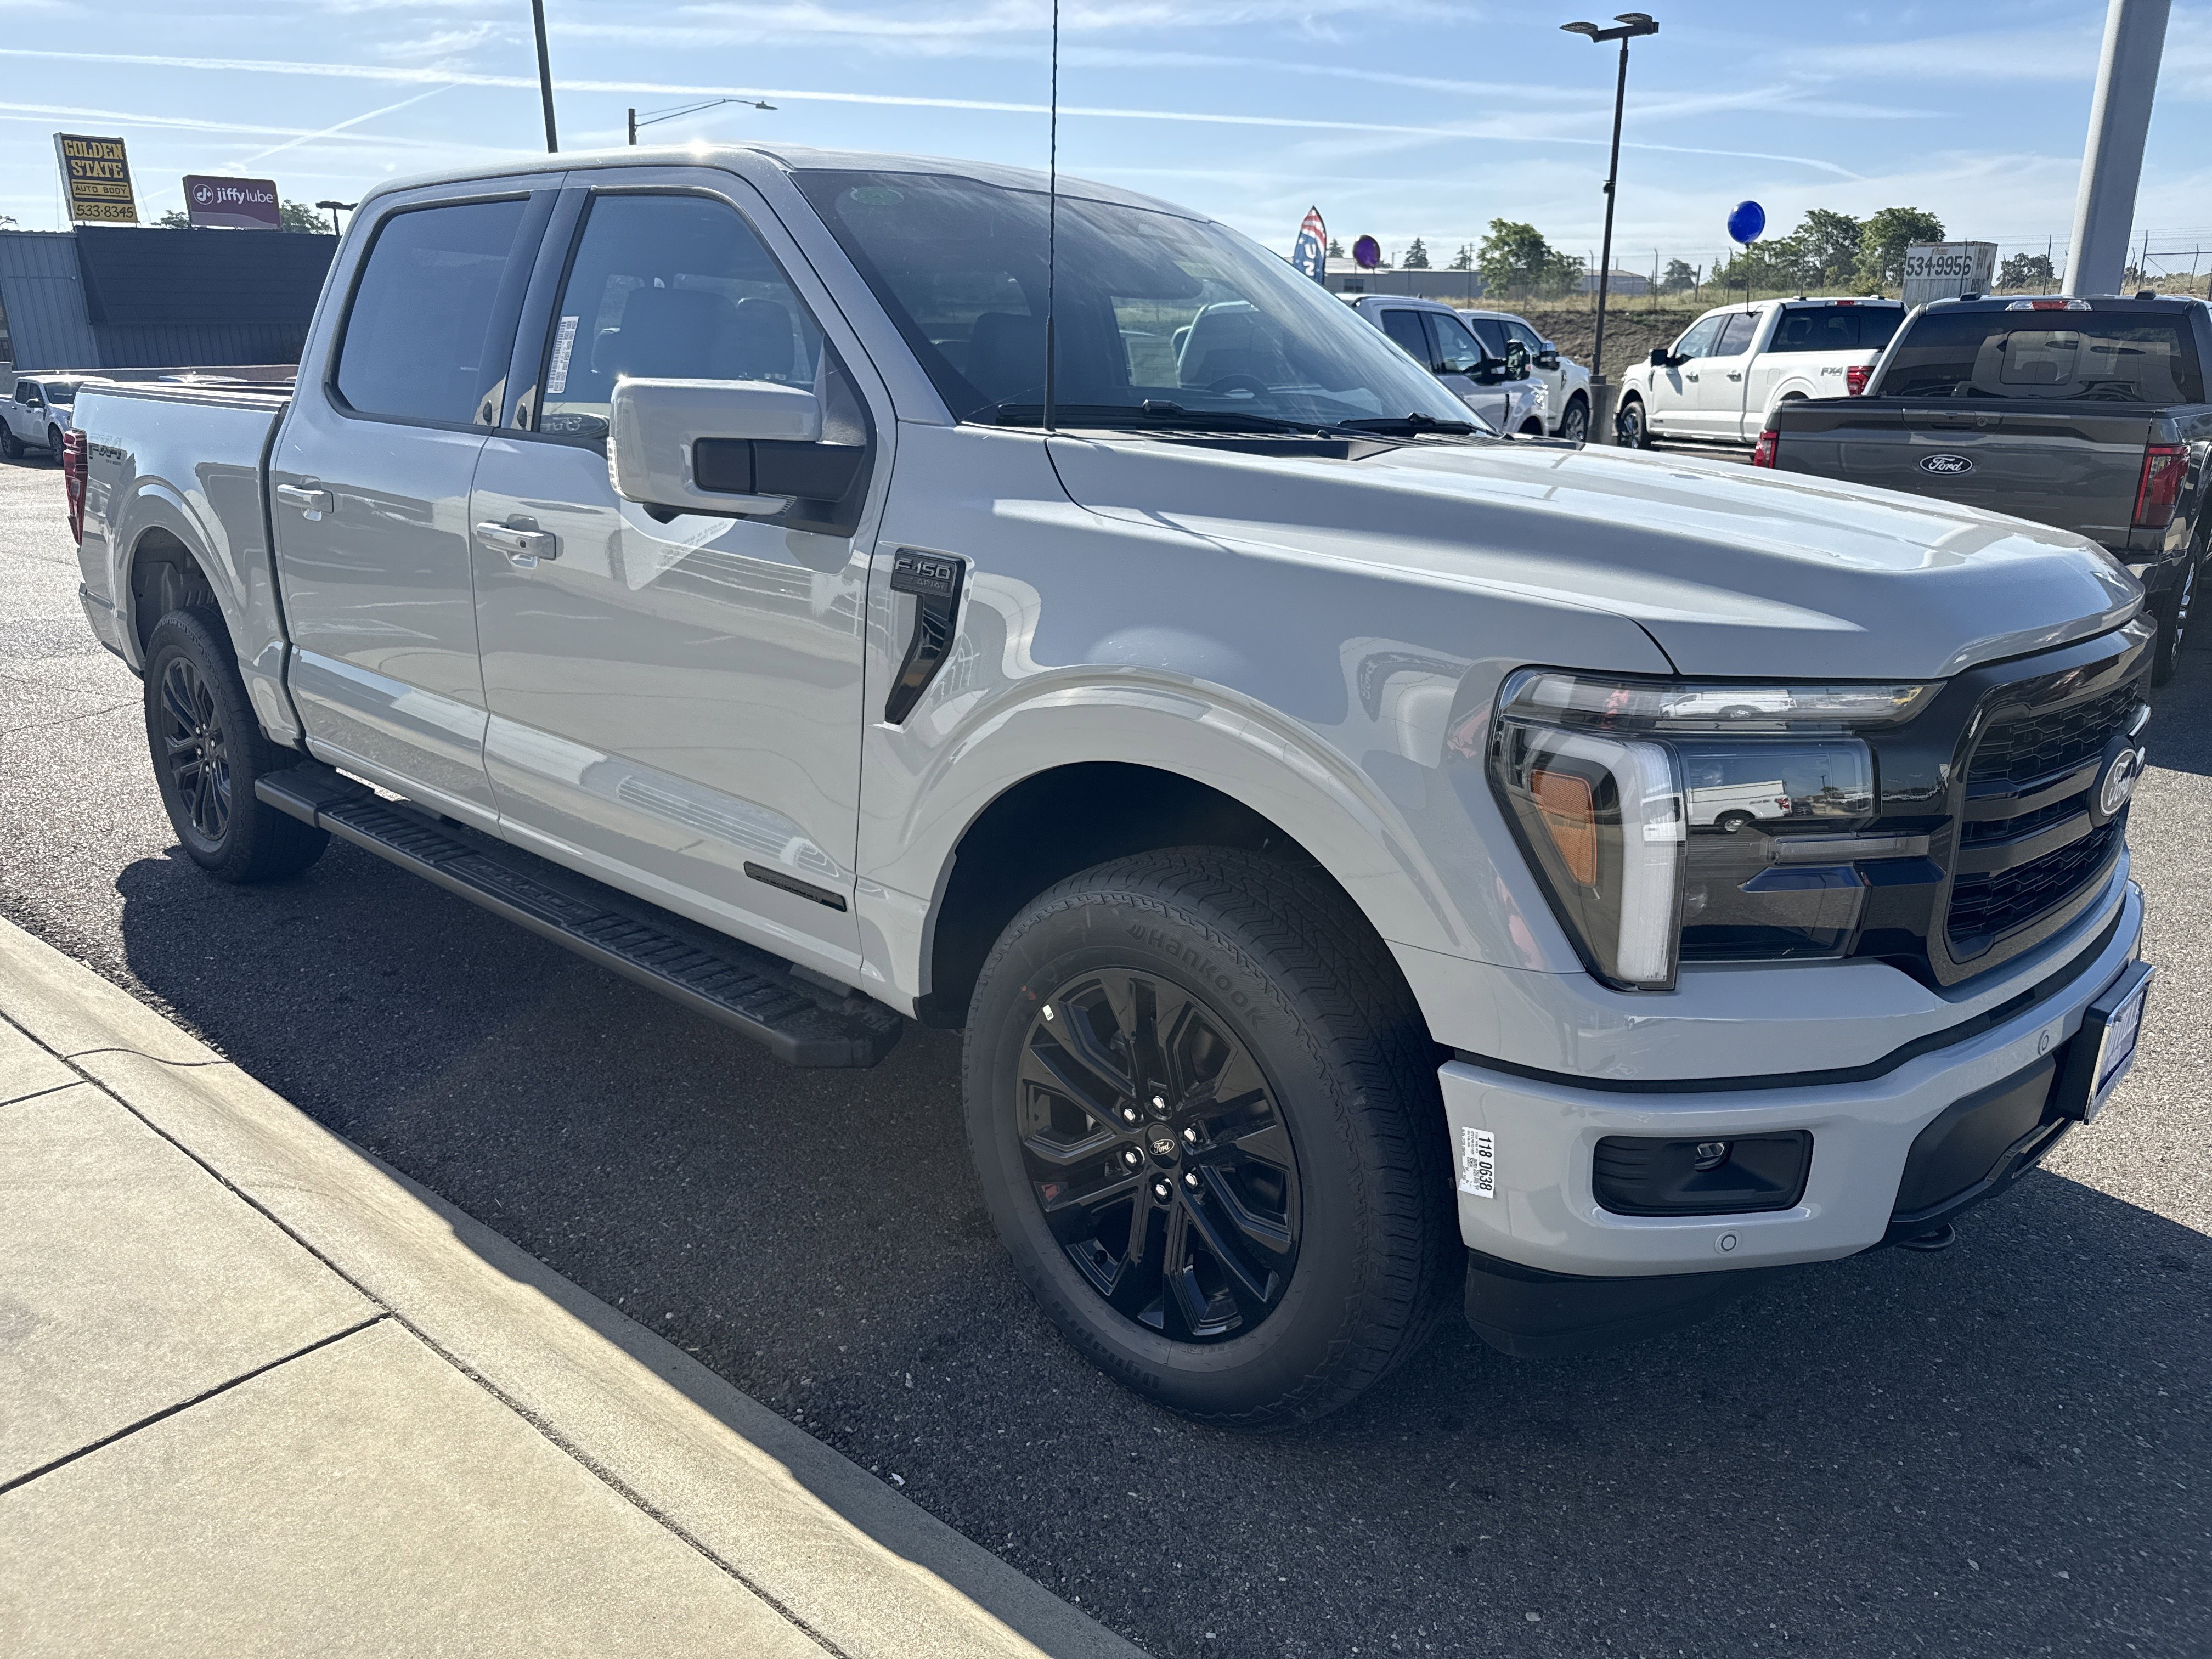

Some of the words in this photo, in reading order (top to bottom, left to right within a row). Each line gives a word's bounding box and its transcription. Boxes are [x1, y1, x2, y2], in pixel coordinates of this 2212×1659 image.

[64, 139, 124, 160] GOLDEN
[71, 159, 124, 178] STATE
[1928, 456, 1963, 471] Ford
[895, 557, 953, 580] F-150
[2107, 759, 2134, 806] Ford
[1154, 1141, 1170, 1154] Ford
[1479, 1137, 1492, 1158] 118
[1479, 1161, 1493, 1191] 0638
